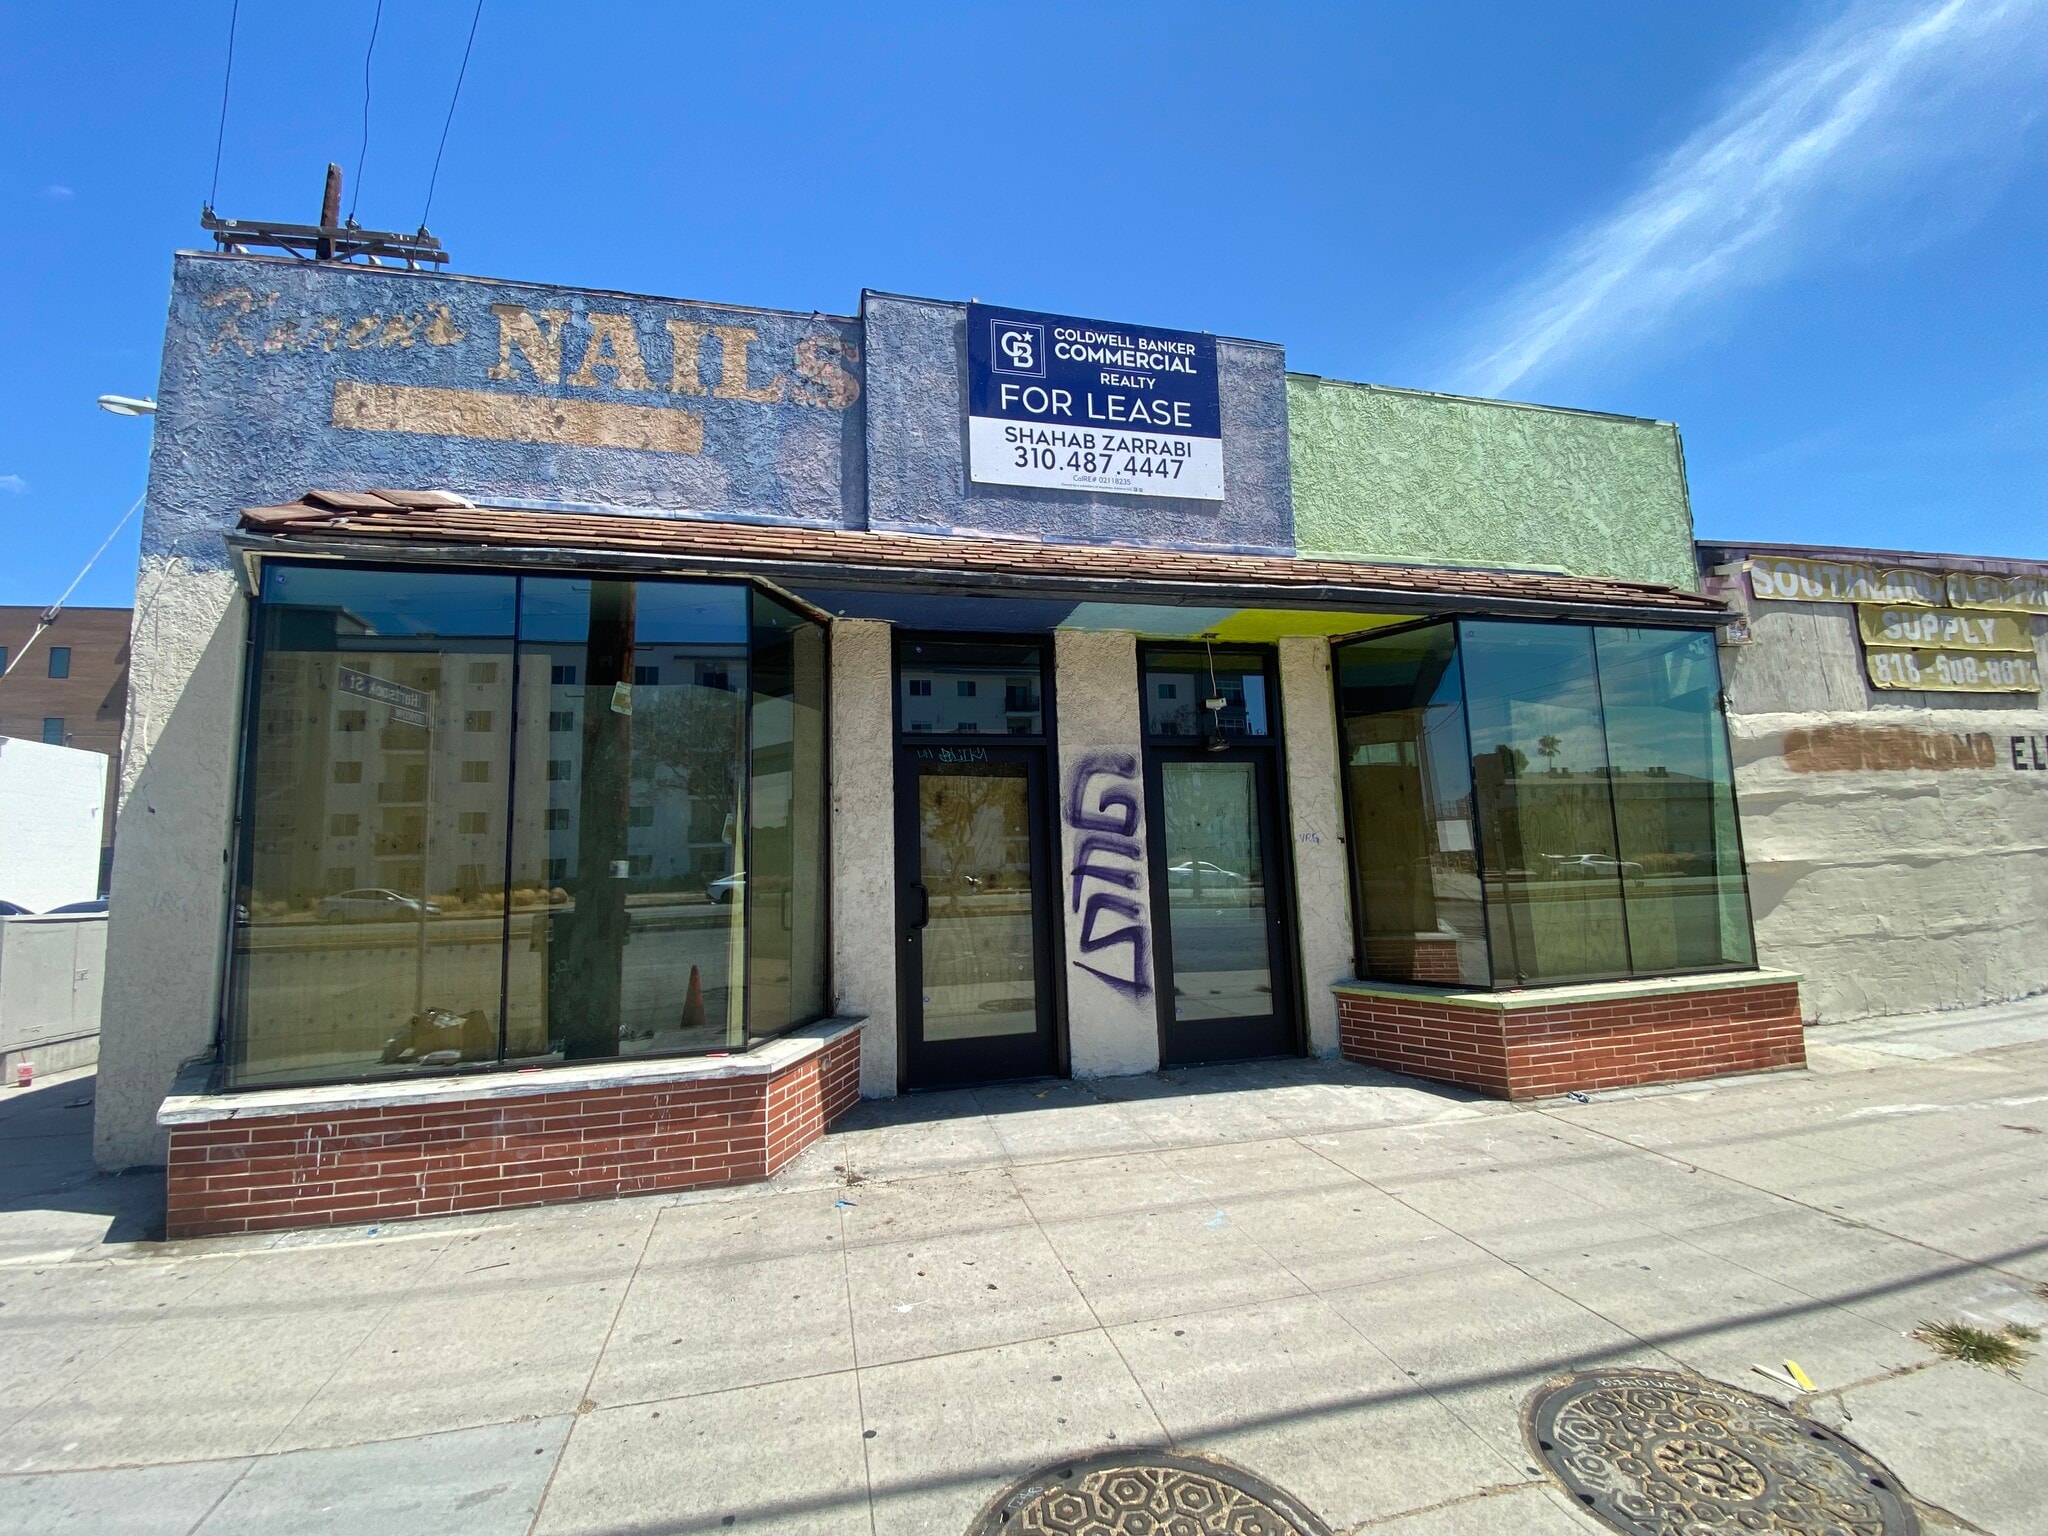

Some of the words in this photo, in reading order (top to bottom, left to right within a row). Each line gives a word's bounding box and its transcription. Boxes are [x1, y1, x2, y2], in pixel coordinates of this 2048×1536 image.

[487, 303, 861, 410] NAILS
[1054, 328, 1135, 349] COLDWELL
[1138, 338, 1196, 355] BANKER
[1054, 343, 1197, 374] COMMERCIAL
[1100, 373, 1156, 389] REALTY
[1001, 383, 1073, 416] FOR
[1087, 393, 1192, 427] LEASE
[1004, 426, 1096, 449] SHAHAB
[1101, 435, 1192, 458] ZARRABI
[1014, 446, 1184, 480] 310.487.4447
[1881, 611, 1996, 645] SUPPLY
[2010, 734, 2048, 771] EL
